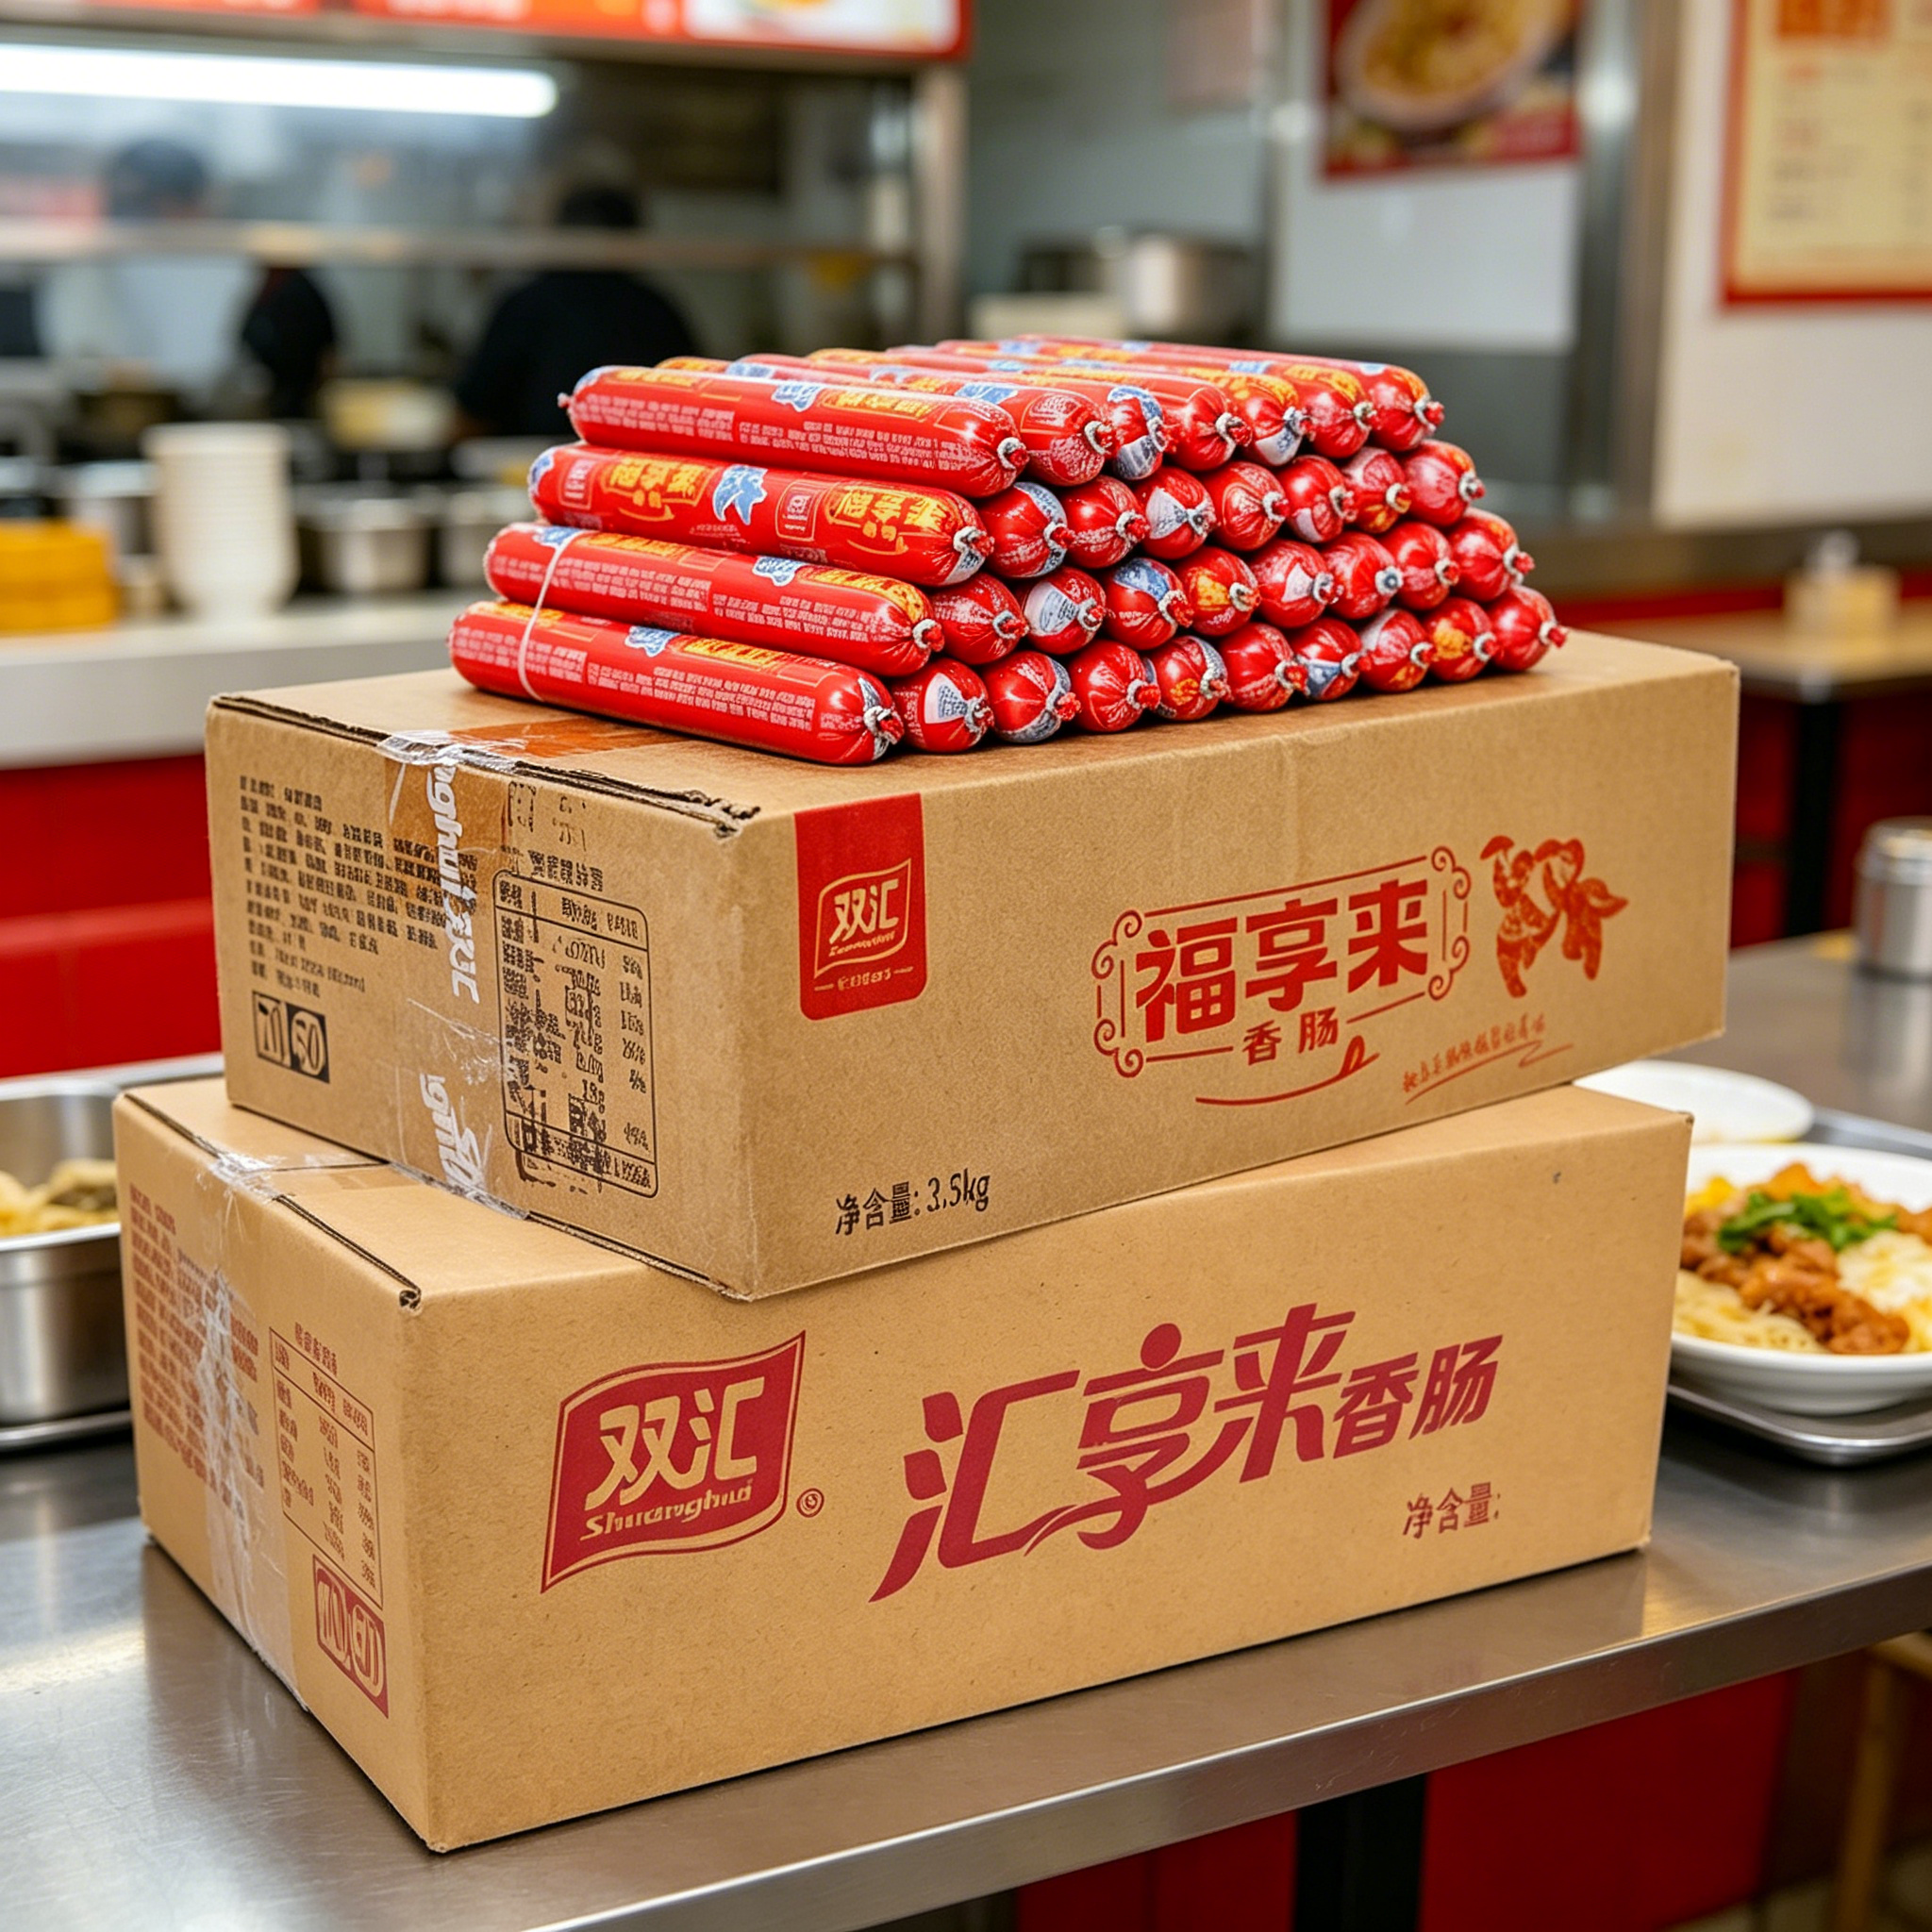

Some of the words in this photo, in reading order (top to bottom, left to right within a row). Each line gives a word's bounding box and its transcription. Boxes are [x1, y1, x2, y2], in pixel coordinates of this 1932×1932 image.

[829, 877, 899, 944] 双汇
[1135, 878, 1428, 1043] 福享来
[1241, 1006, 1340, 1066] 香肠
[583, 1375, 765, 1511] 双汇
